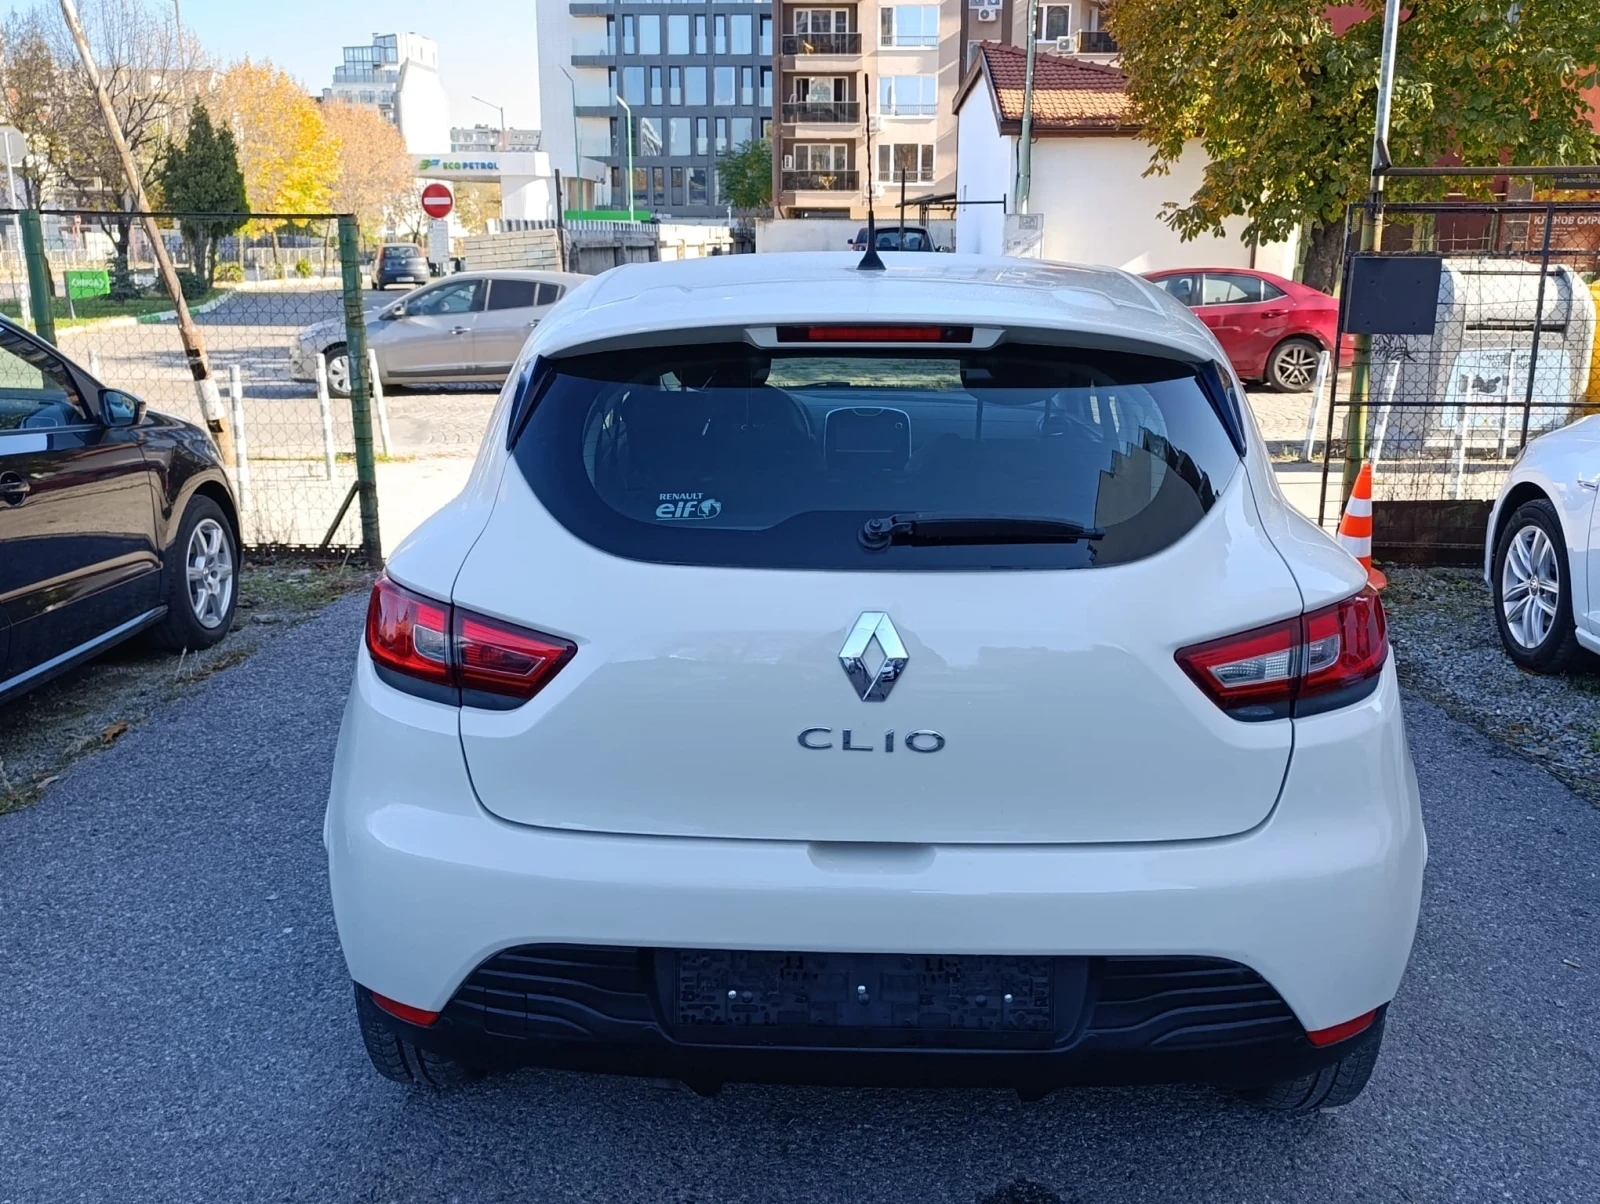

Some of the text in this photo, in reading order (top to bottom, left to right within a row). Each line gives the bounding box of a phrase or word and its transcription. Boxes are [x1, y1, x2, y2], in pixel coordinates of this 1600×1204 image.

[462, 162, 499, 170] PETROL
[659, 492, 704, 501] RENAULT
[655, 501, 698, 518] elf
[797, 725, 946, 753] CLIO
